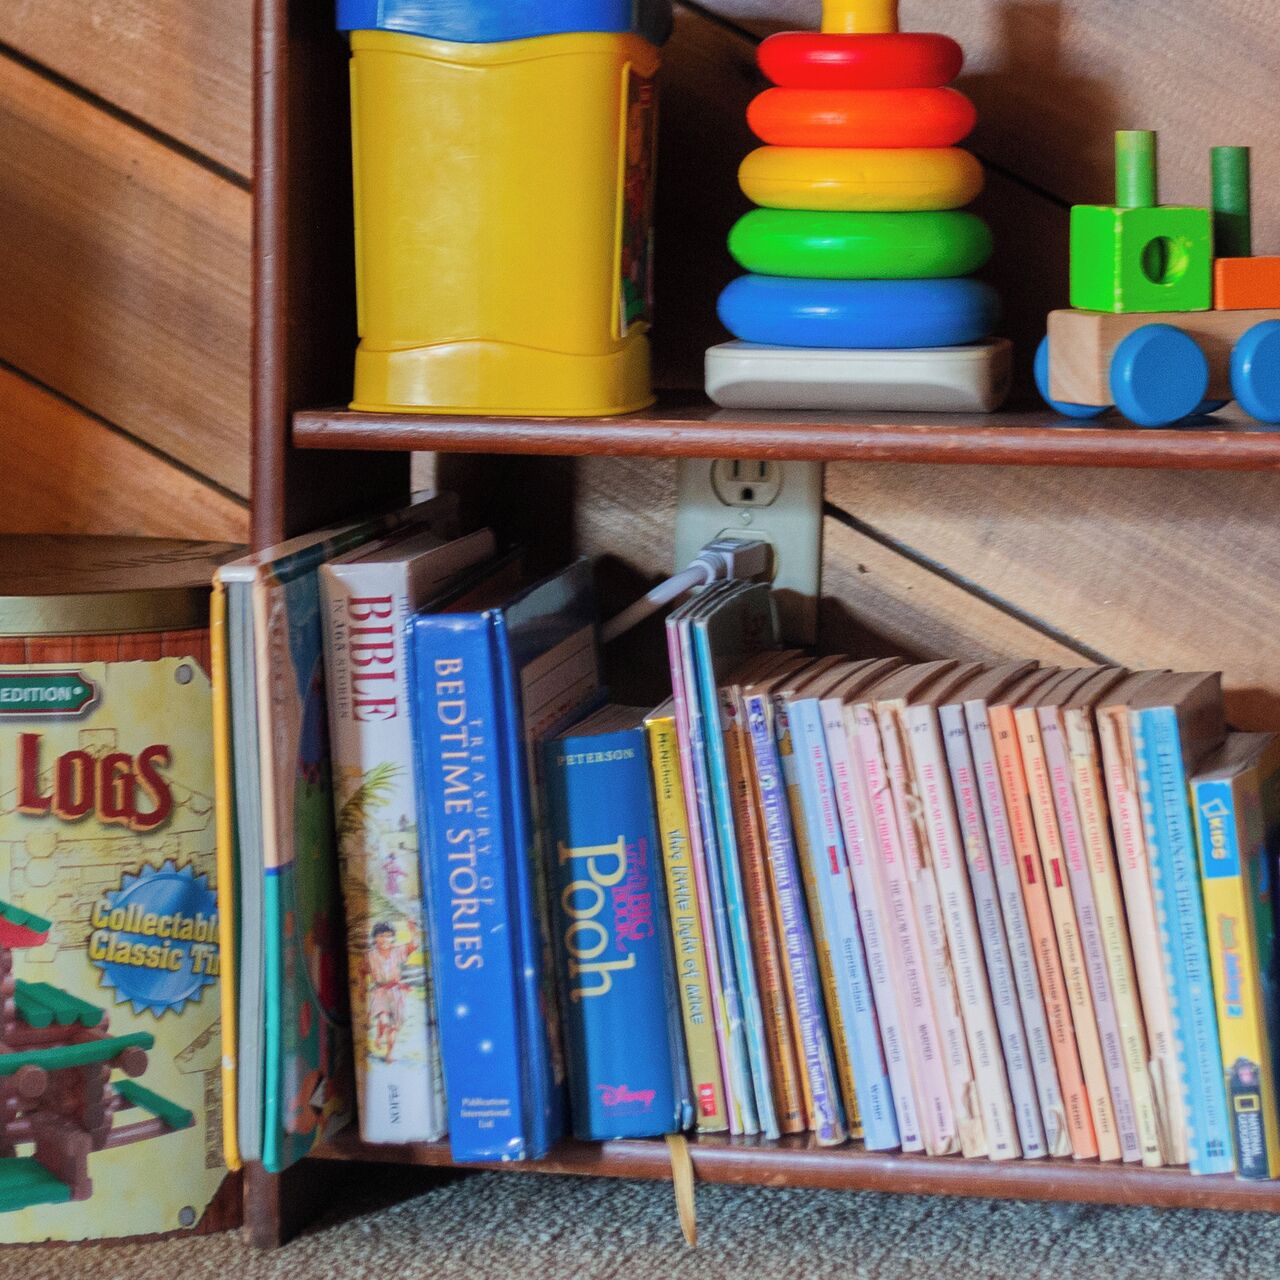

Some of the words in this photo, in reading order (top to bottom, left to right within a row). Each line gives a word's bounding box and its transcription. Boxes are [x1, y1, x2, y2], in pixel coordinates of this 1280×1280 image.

[332, 598, 344, 613] IN
[333, 619, 347, 651] 365
[344, 594, 400, 722] BIBLE
[0, 686, 70, 703] EDITION
[334, 657, 350, 718] STORIES
[434, 657, 472, 814] BEDTIME
[557, 748, 635, 766] PETERSON
[655, 732, 677, 799] McNicholas
[835, 761, 846, 776] THE
[922, 762, 935, 781] THE
[956, 767, 969, 784] THE
[981, 760, 994, 777] THE
[1053, 766, 1065, 783] THE
[1077, 767, 1090, 783] THE
[18, 732, 173, 830] LOGS
[468, 718, 491, 855] TREASURY
[839, 781, 854, 816] BOXCAR
[985, 780, 1002, 817] BOXCAR
[1156, 752, 1177, 809] LITTLE
[865, 759, 879, 775] THE
[877, 817, 896, 863] CHILDREN
[926, 783, 942, 819] BOXCAR
[1056, 785, 1072, 823] BOXCAR
[1080, 788, 1096, 823] BOXCAR
[765, 806, 791, 885] ENCYCLOPEDIA
[846, 819, 863, 865] CHILDREN
[933, 821, 952, 869] CHILDREN
[992, 818, 1011, 866] CHILDREN
[1064, 824, 1082, 872] CHILDREN
[1088, 826, 1105, 873] CHILDREN
[1120, 822, 1137, 869] CHILDREN
[1165, 813, 1184, 857] TOWN
[1207, 817, 1227, 859] KIDS
[1171, 859, 1186, 875] ON
[445, 827, 484, 970] STORIES
[889, 879, 902, 896] THE
[1172, 887, 1191, 914] THE
[557, 834, 637, 1003] Pooh
[893, 899, 908, 931] YELLOW
[1080, 904, 1093, 926] TREE
[89, 928, 185, 971] Classic
[674, 917, 700, 953] light
[786, 932, 803, 956] BOY
[899, 935, 915, 966] HOUSE
[1062, 922, 1077, 963] Caboose
[1085, 929, 1099, 960] HOUSE
[1178, 922, 1200, 983] PRAIRIE
[680, 959, 702, 977] of
[842, 937, 859, 978] Surprise
[790, 956, 813, 1016] DETECTIVE
[850, 981, 865, 1012] Island
[863, 909, 879, 949] MYSTERY
[886, 1026, 900, 1062] WARNER
[906, 968, 922, 1007] MYSTERY
[994, 967, 1011, 1005] MYSTERY
[1069, 966, 1086, 1007] Mystery
[1091, 962, 1107, 1003] MYSTERY
[1019, 960, 1036, 999] MYSTERY
[1032, 1026, 1048, 1063] WARNER
[1112, 954, 1127, 993] MYSTERY
[1126, 1036, 1141, 1072] WARNER
[917, 1024, 933, 1061] WARNER
[975, 1030, 990, 1067] WARNER
[1038, 937, 1059, 1000] Schoolhouse
[1049, 1004, 1068, 1044] Mystery
[1069, 1093, 1084, 1129] Warner
[1104, 1031, 1119, 1069] WARNER
[596, 1084, 657, 1107] Disney
[869, 1084, 884, 1120] Warner
[1095, 1097, 1111, 1134] Warner
[1248, 1112, 1262, 1156] NATIONAL
[1237, 1113, 1254, 1169] GEOGRAPHIC
